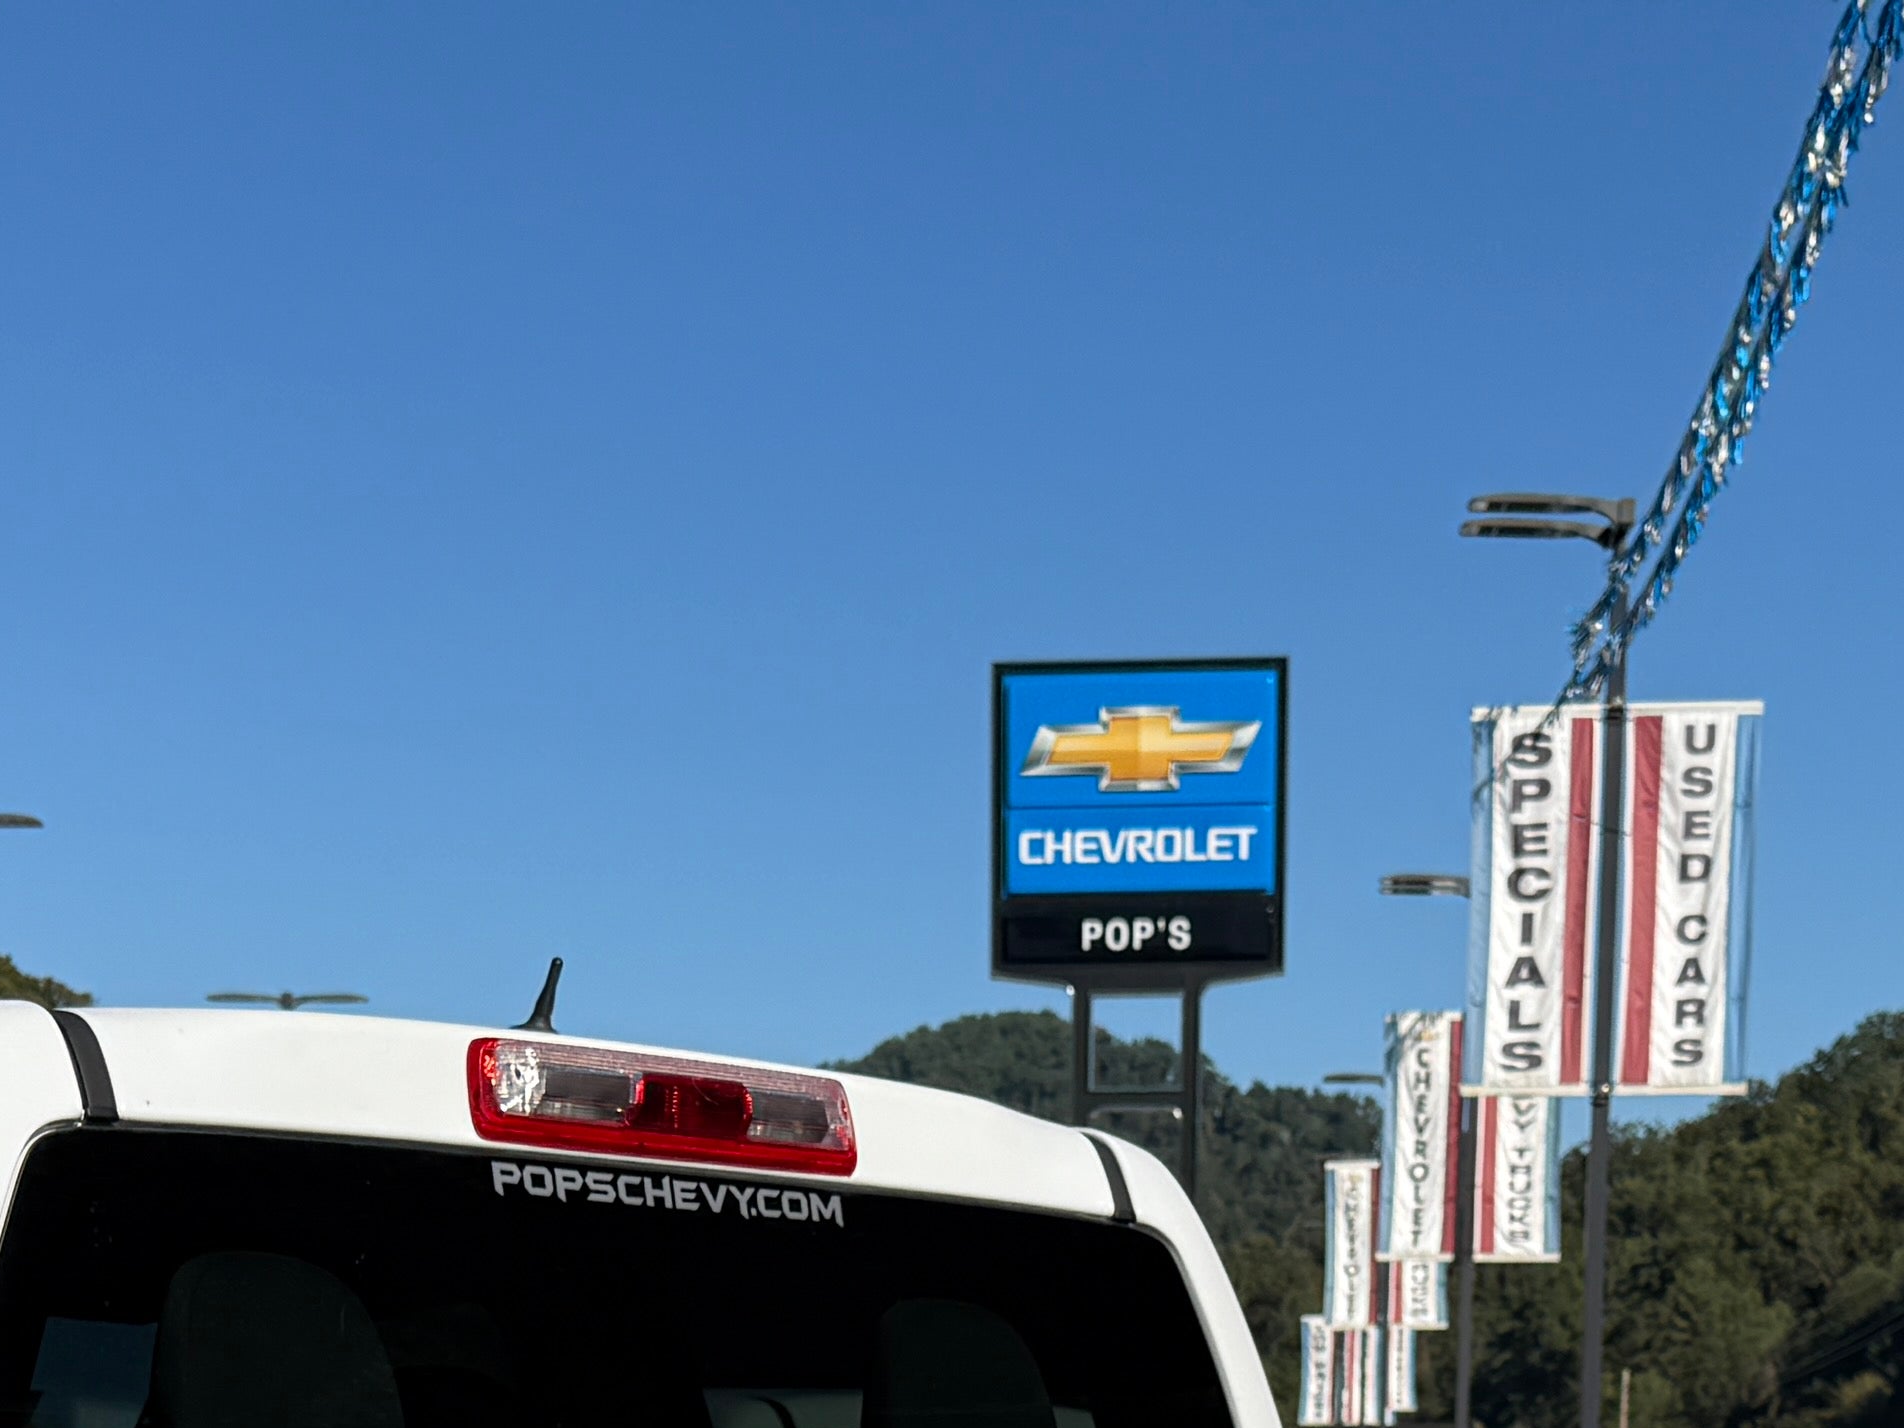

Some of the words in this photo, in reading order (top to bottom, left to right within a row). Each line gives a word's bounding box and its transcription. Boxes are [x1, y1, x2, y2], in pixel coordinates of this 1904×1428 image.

[1018, 826, 1258, 866] CHEVROLET
[1679, 724, 1717, 885] USED
[1080, 917, 1194, 953] POP'S
[1499, 732, 1553, 1073] SPECIALS
[1673, 914, 1710, 1068] CARS
[491, 1160, 845, 1228] POPSCHEVY.COM
[1409, 1049, 1431, 1247] CHEVROLET
